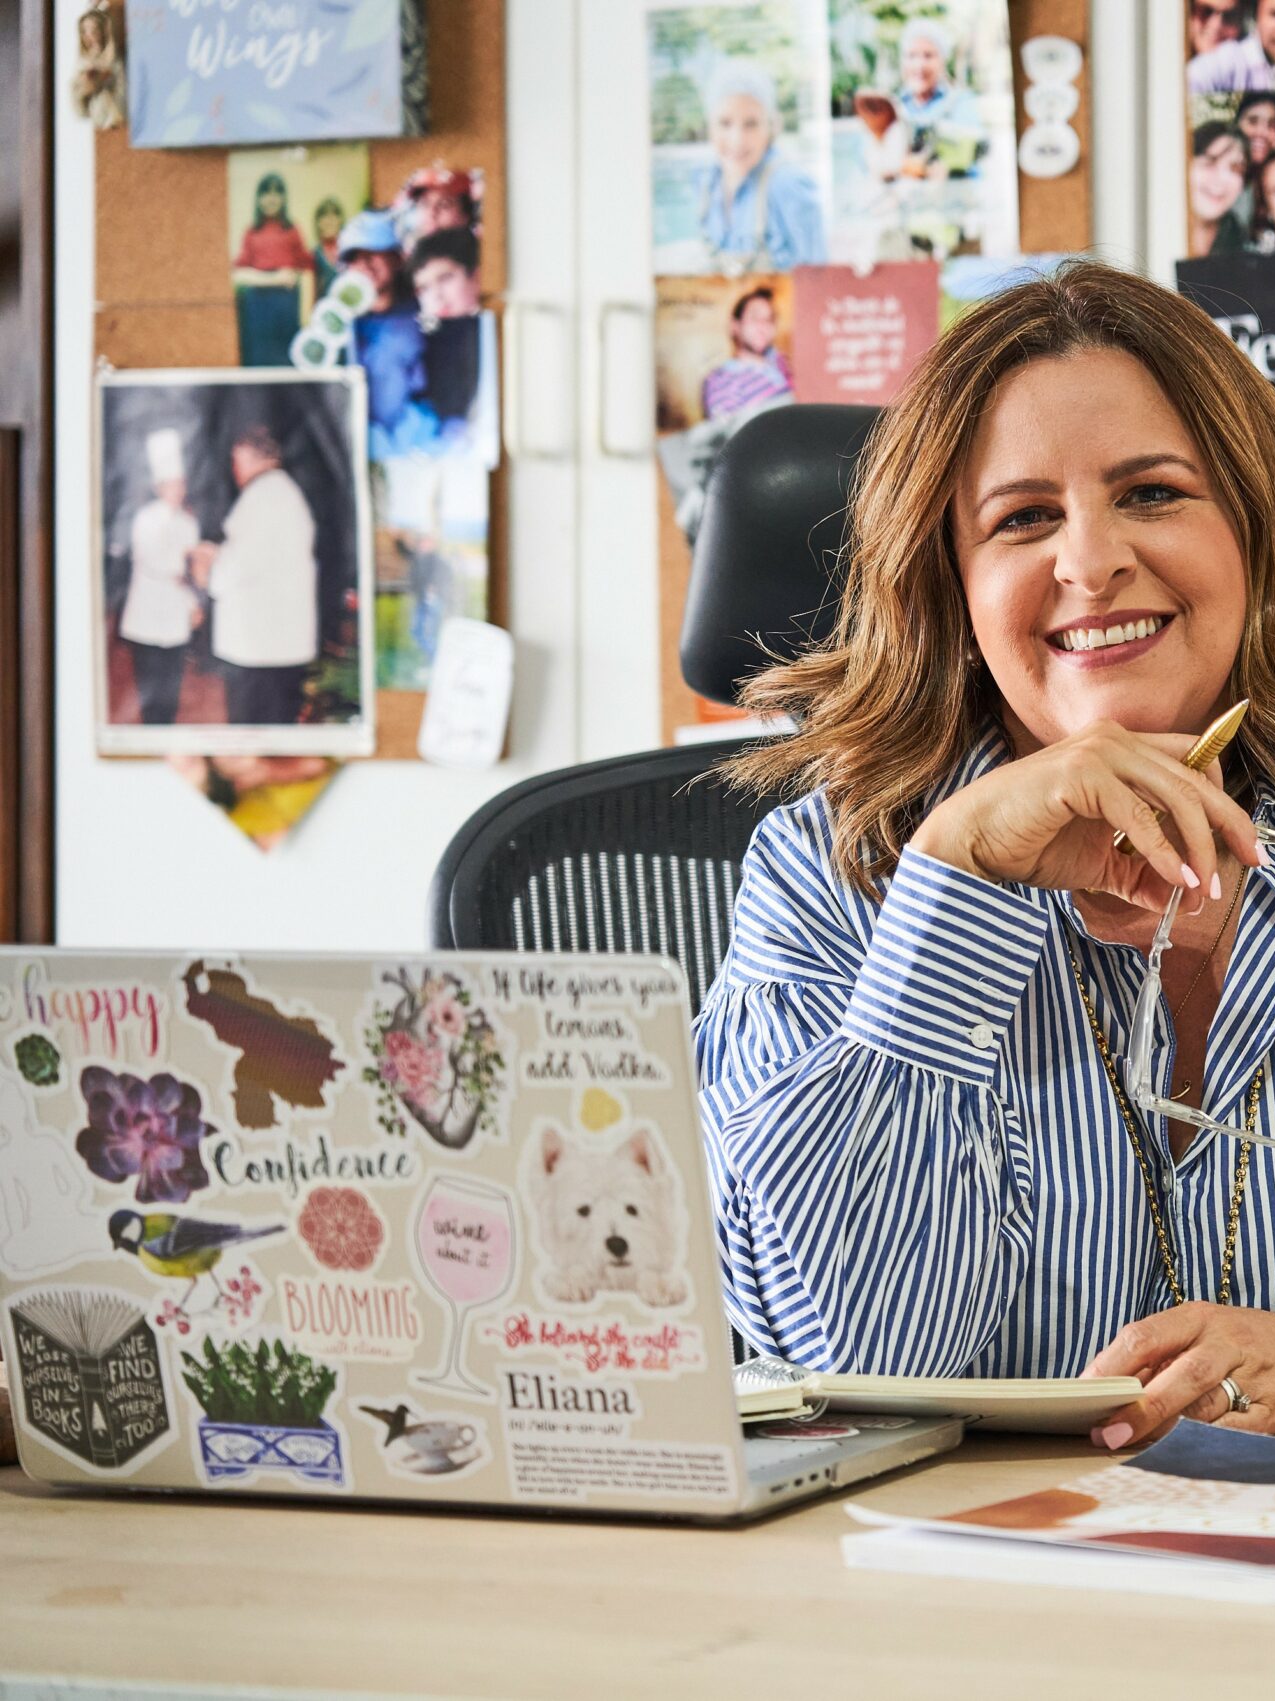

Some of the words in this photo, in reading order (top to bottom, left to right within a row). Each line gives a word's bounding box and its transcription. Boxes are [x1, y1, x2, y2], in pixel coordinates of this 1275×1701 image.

[187, 19, 335, 90] Wings
[519, 968, 561, 1003] life
[566, 972, 623, 1009] gives
[23, 963, 162, 1059] happy
[527, 1052, 574, 1079] add
[212, 1136, 416, 1199] Confidence
[284, 1280, 418, 1340] BLOOMING
[19, 1333, 46, 1355] WE
[120, 1334, 148, 1357] WE
[36, 1351, 69, 1364] LOST
[24, 1366, 80, 1392] OURSELVES
[108, 1359, 156, 1383] FIND
[42, 1388, 60, 1402] IN
[106, 1381, 163, 1404] OURSELVES
[506, 1371, 635, 1415] Eliana
[118, 1400, 158, 1418] THERE
[123, 1419, 155, 1447] TOO
